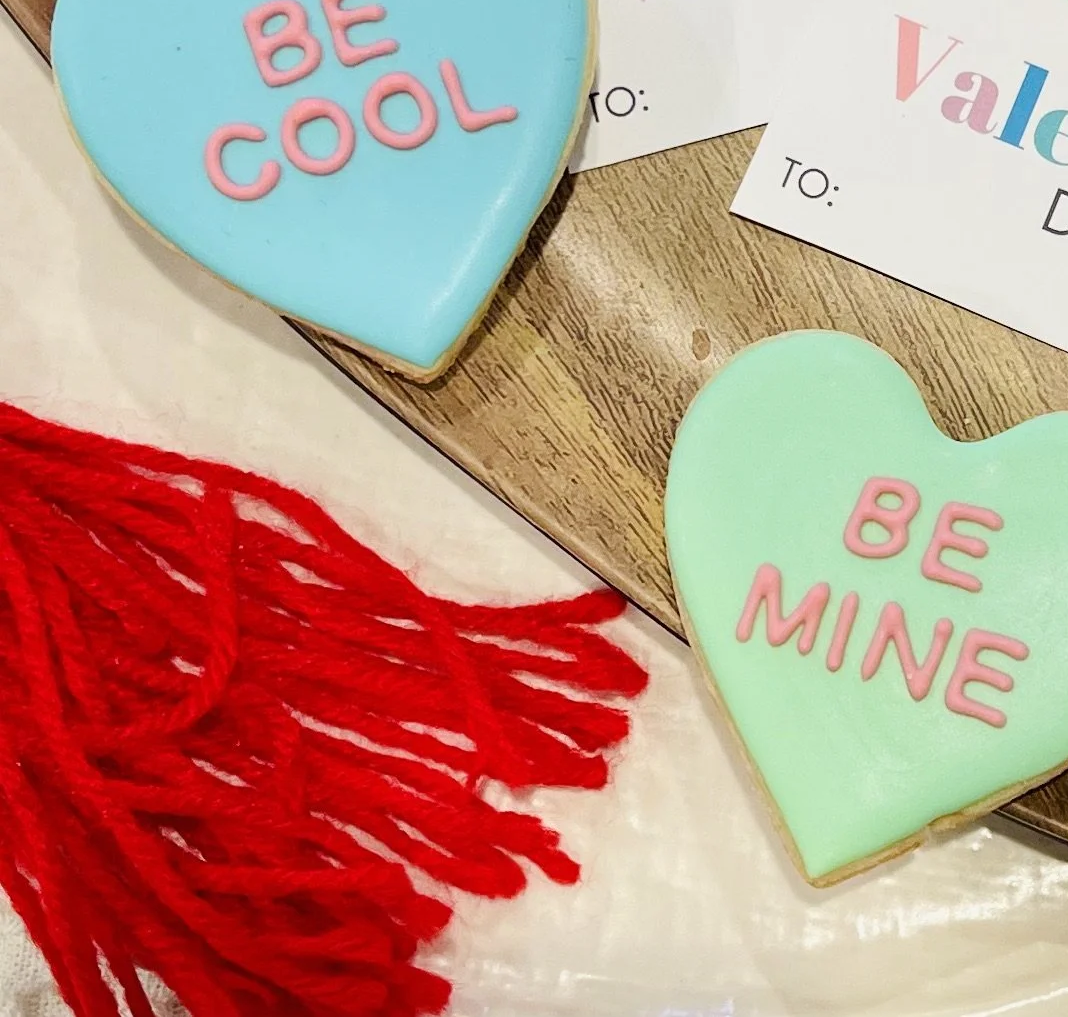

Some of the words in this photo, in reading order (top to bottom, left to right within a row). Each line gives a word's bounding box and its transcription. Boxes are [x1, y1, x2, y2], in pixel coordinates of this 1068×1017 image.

[203, 58, 518, 202] COOL
[589, 87, 648, 122] TO:
[781, 156, 840, 207] TO:
[843, 476, 1005, 593] BE
[735, 562, 1030, 729] MINE
